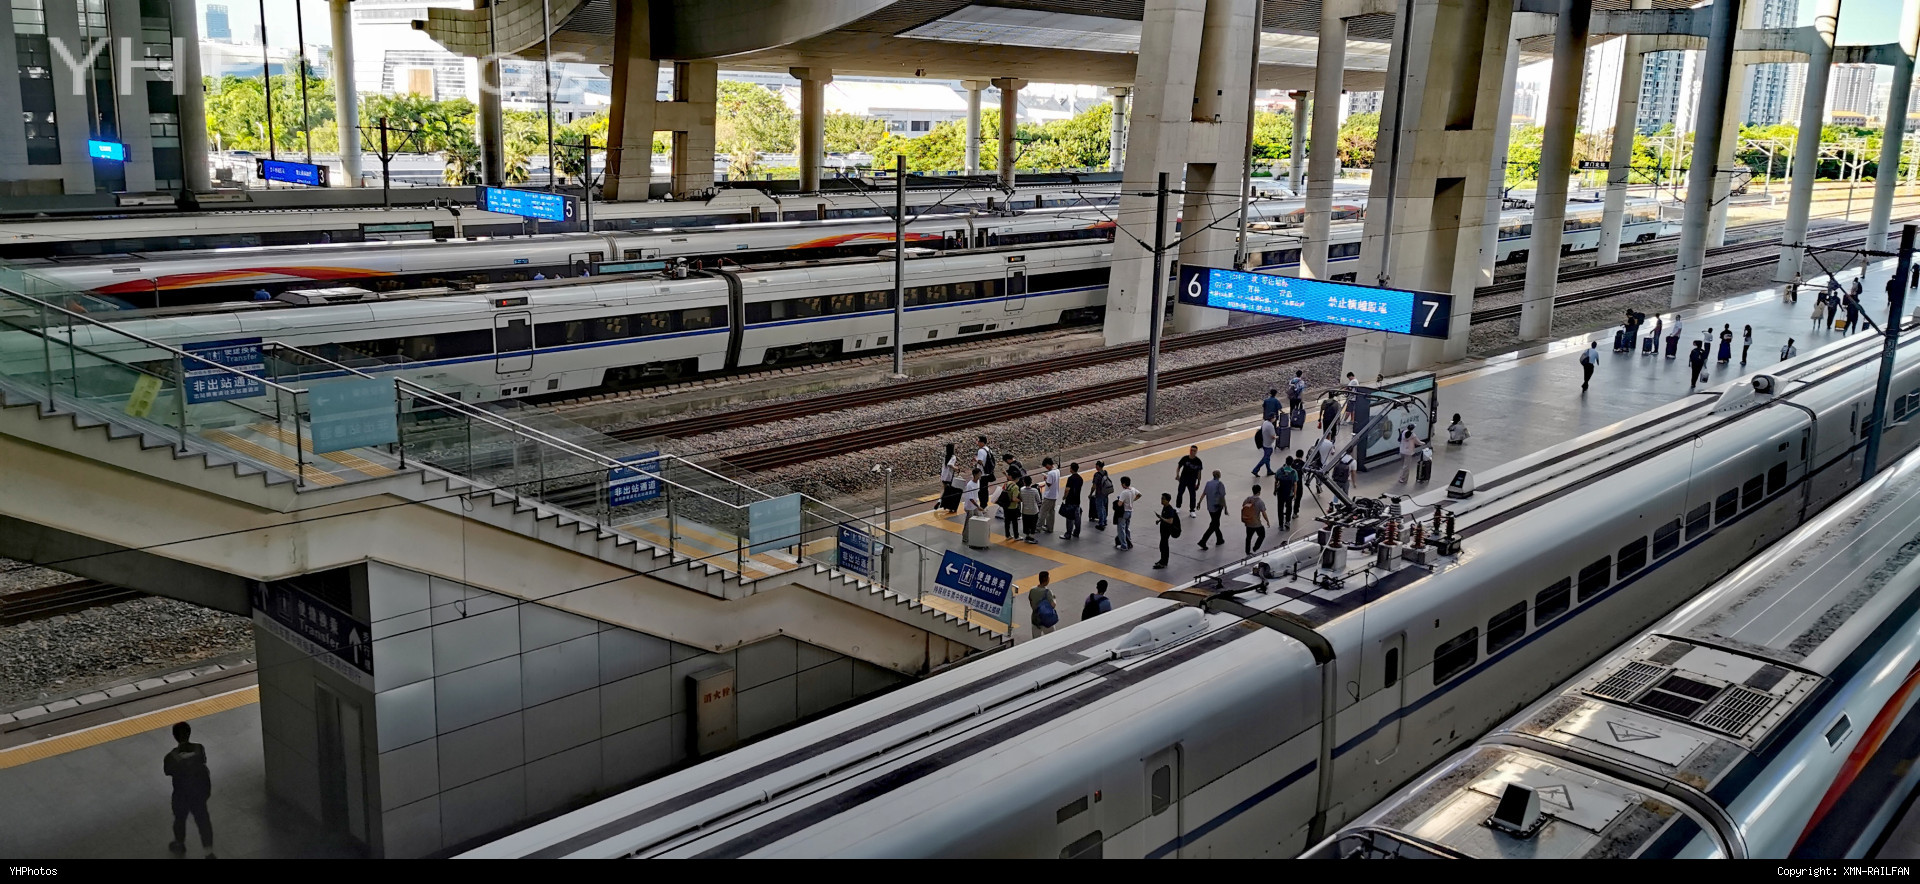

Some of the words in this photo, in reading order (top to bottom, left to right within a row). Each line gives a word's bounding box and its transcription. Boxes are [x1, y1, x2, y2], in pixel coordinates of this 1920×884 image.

[258, 161, 264, 175] 2
[318, 169, 325, 184] 3
[479, 190, 485, 205] 4
[565, 200, 573, 217] 5
[1187, 273, 1202, 298] 6
[1422, 300, 1440, 328] 7
[226, 353, 258, 362] Transfer
[193, 374, 259, 392] 非出站通道
[614, 480, 656, 497] 非出站通道
[842, 551, 869, 568] 非出站通
[975, 580, 1002, 597] Transfer
[977, 571, 1006, 590] 便捷换乘
[299, 617, 340, 650] Transfer
[703, 687, 731, 704] 消火栓
